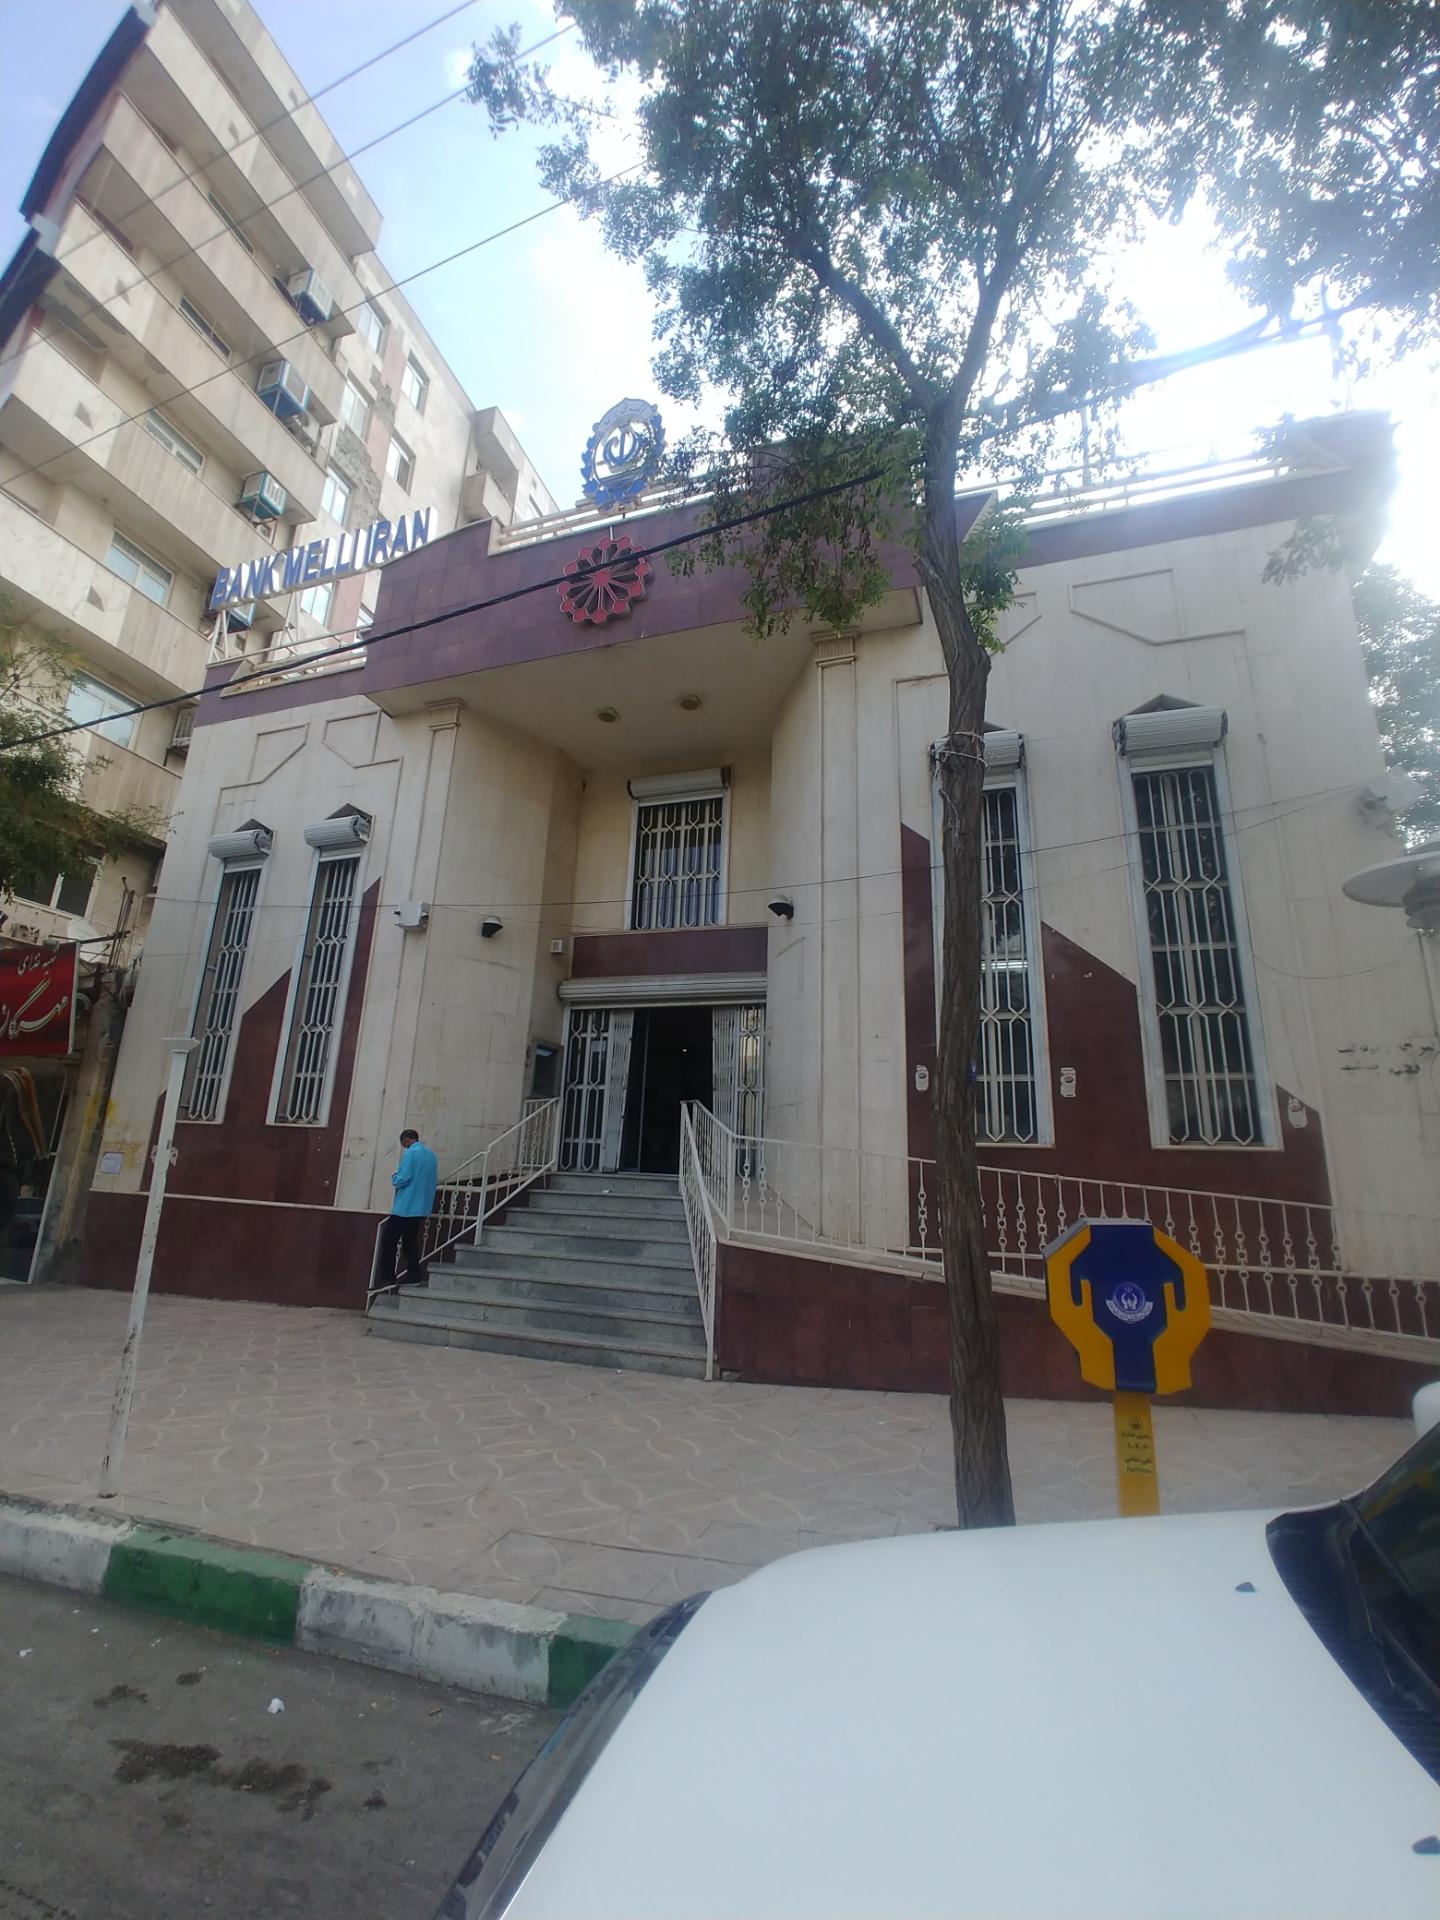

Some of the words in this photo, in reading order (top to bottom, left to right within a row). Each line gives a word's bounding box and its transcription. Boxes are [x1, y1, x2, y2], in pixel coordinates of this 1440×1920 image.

[208, 552, 283, 611] BANK
[281, 528, 364, 589] MELLI
[363, 506, 434, 568] IRAN
[17, 952, 41, 976] غذای
